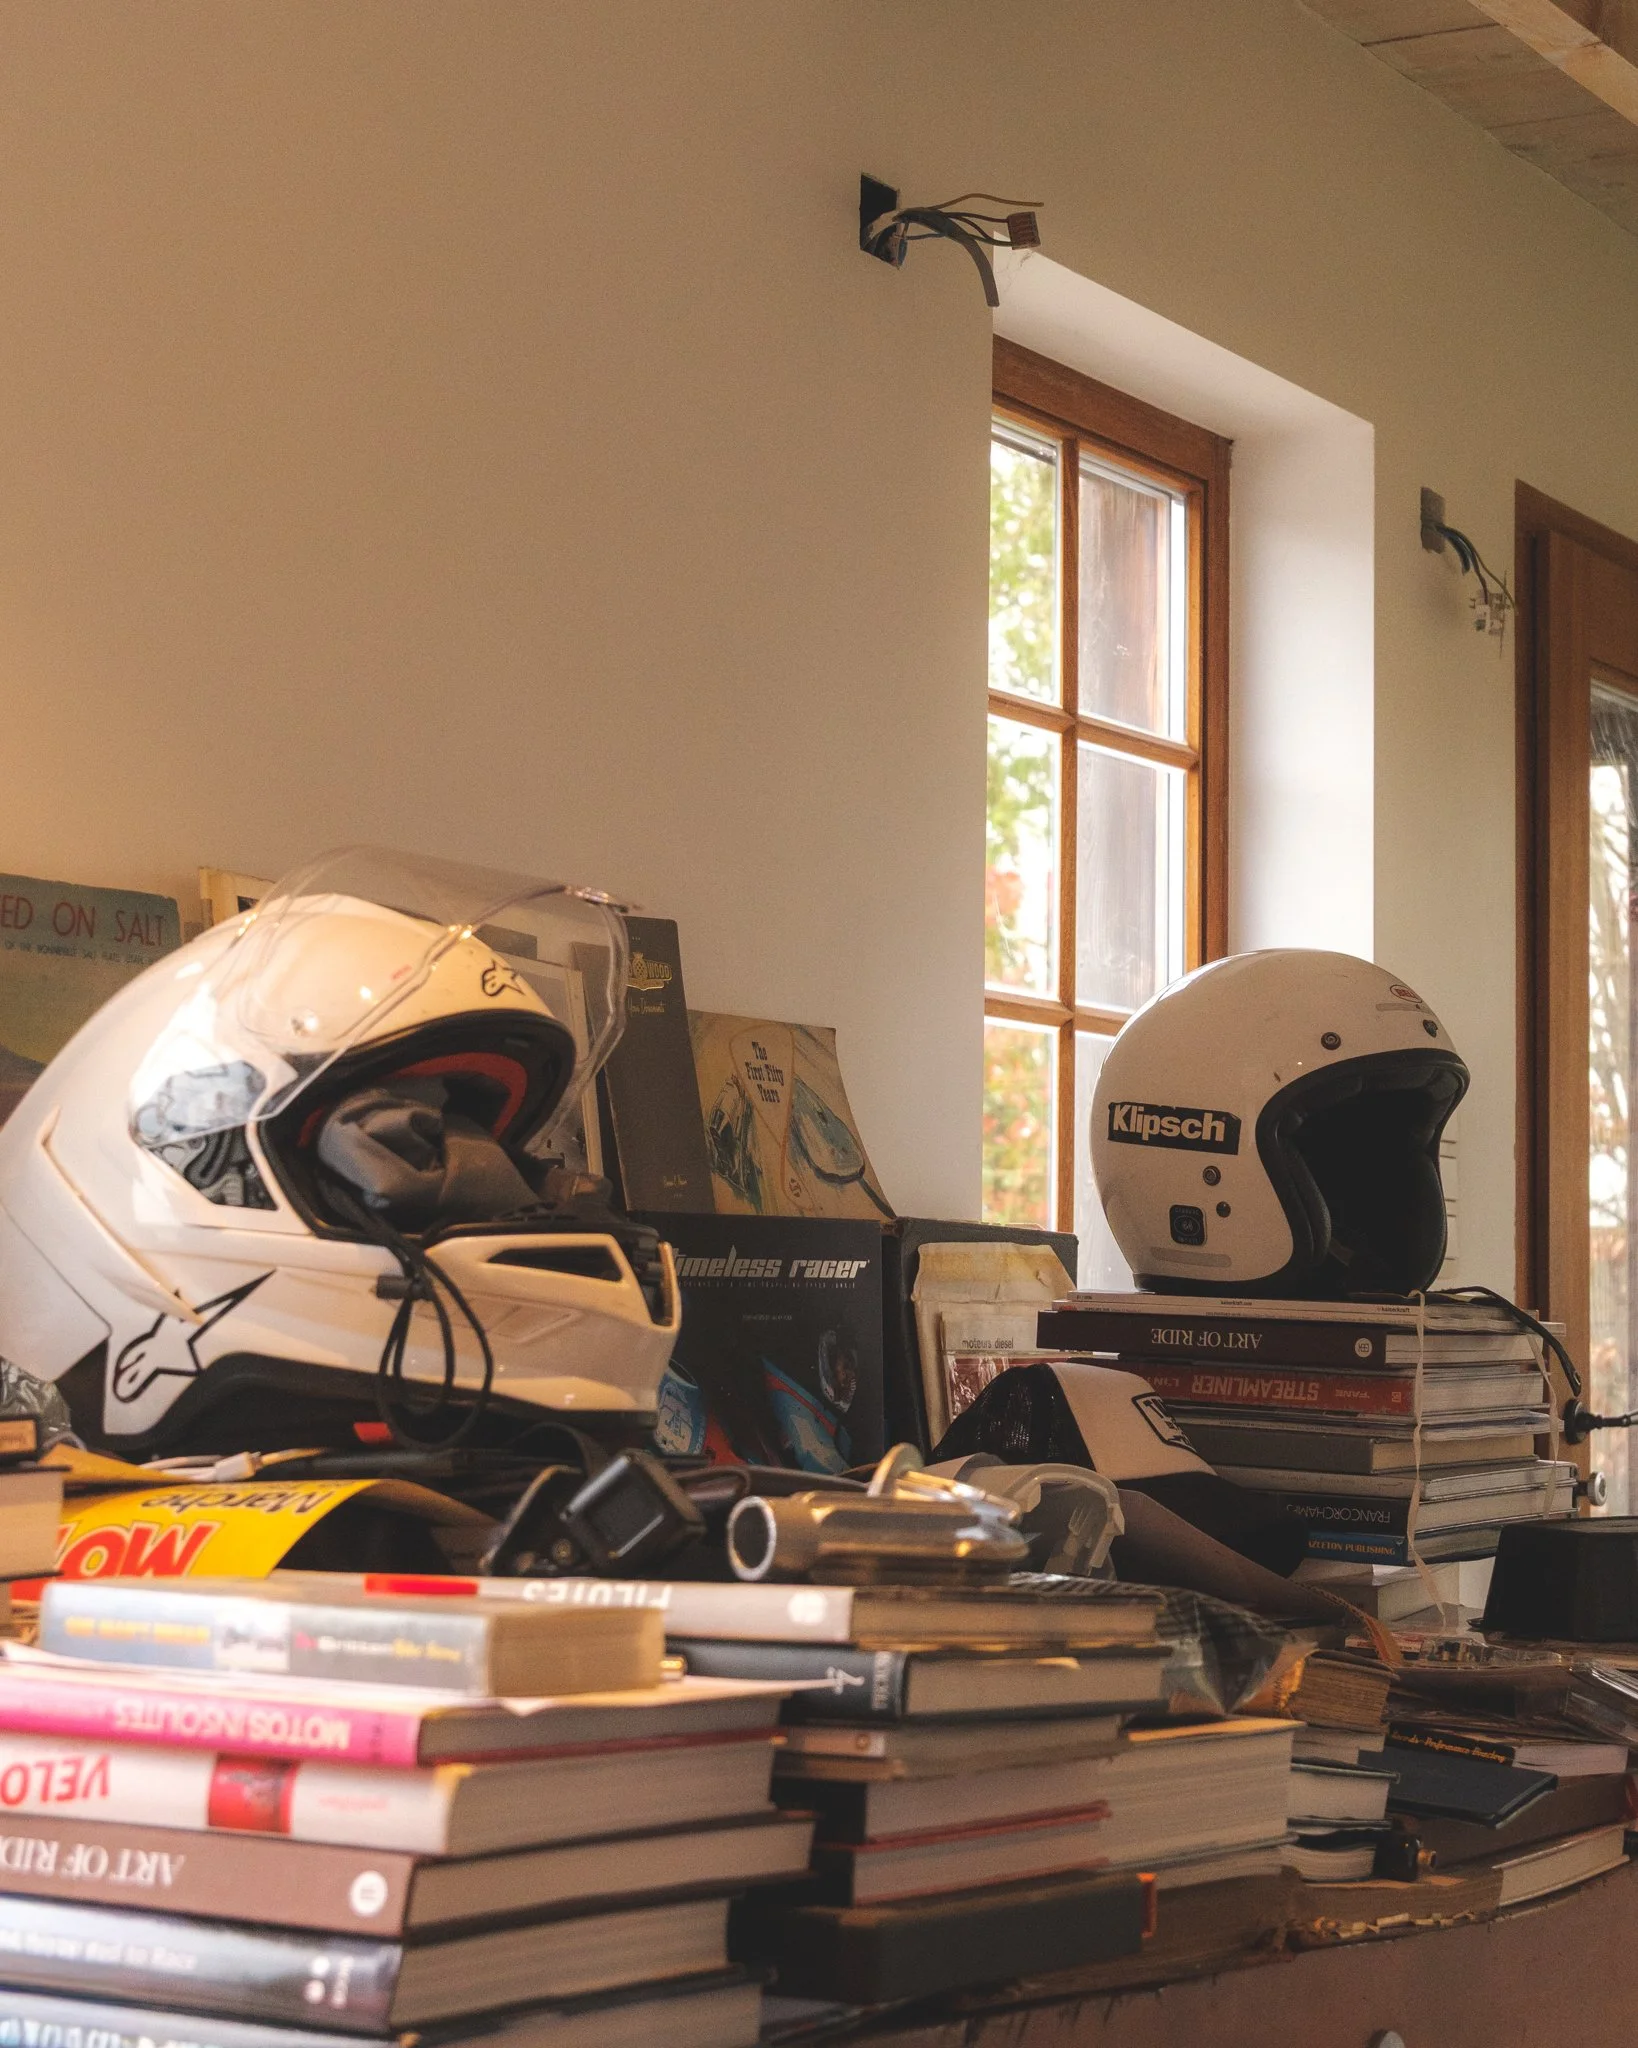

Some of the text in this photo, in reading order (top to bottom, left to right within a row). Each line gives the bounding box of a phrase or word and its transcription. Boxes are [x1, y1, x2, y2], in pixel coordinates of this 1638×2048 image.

[0, 895, 167, 946] ED ON SALT
[751, 1041, 768, 1061] The
[744, 1061, 785, 1087] First Fifty
[756, 1083, 781, 1103] Years
[1112, 1103, 1227, 1142] Klipsch
[788, 1259, 868, 1279] racer
[961, 1336, 1014, 1349] moteurs diesel
[1151, 1328, 1263, 1349] ART OF RIDE
[1191, 1374, 1321, 1401] STREAMLINER
[140, 1490, 335, 1514] Marche
[1345, 1543, 1396, 1556] PUBLISHING
[114, 1699, 249, 1741] INSOLITES
[249, 1708, 350, 1751] MOTOS
[0, 1754, 110, 1808] VELO
[0, 1836, 186, 1887] ART OF RID
